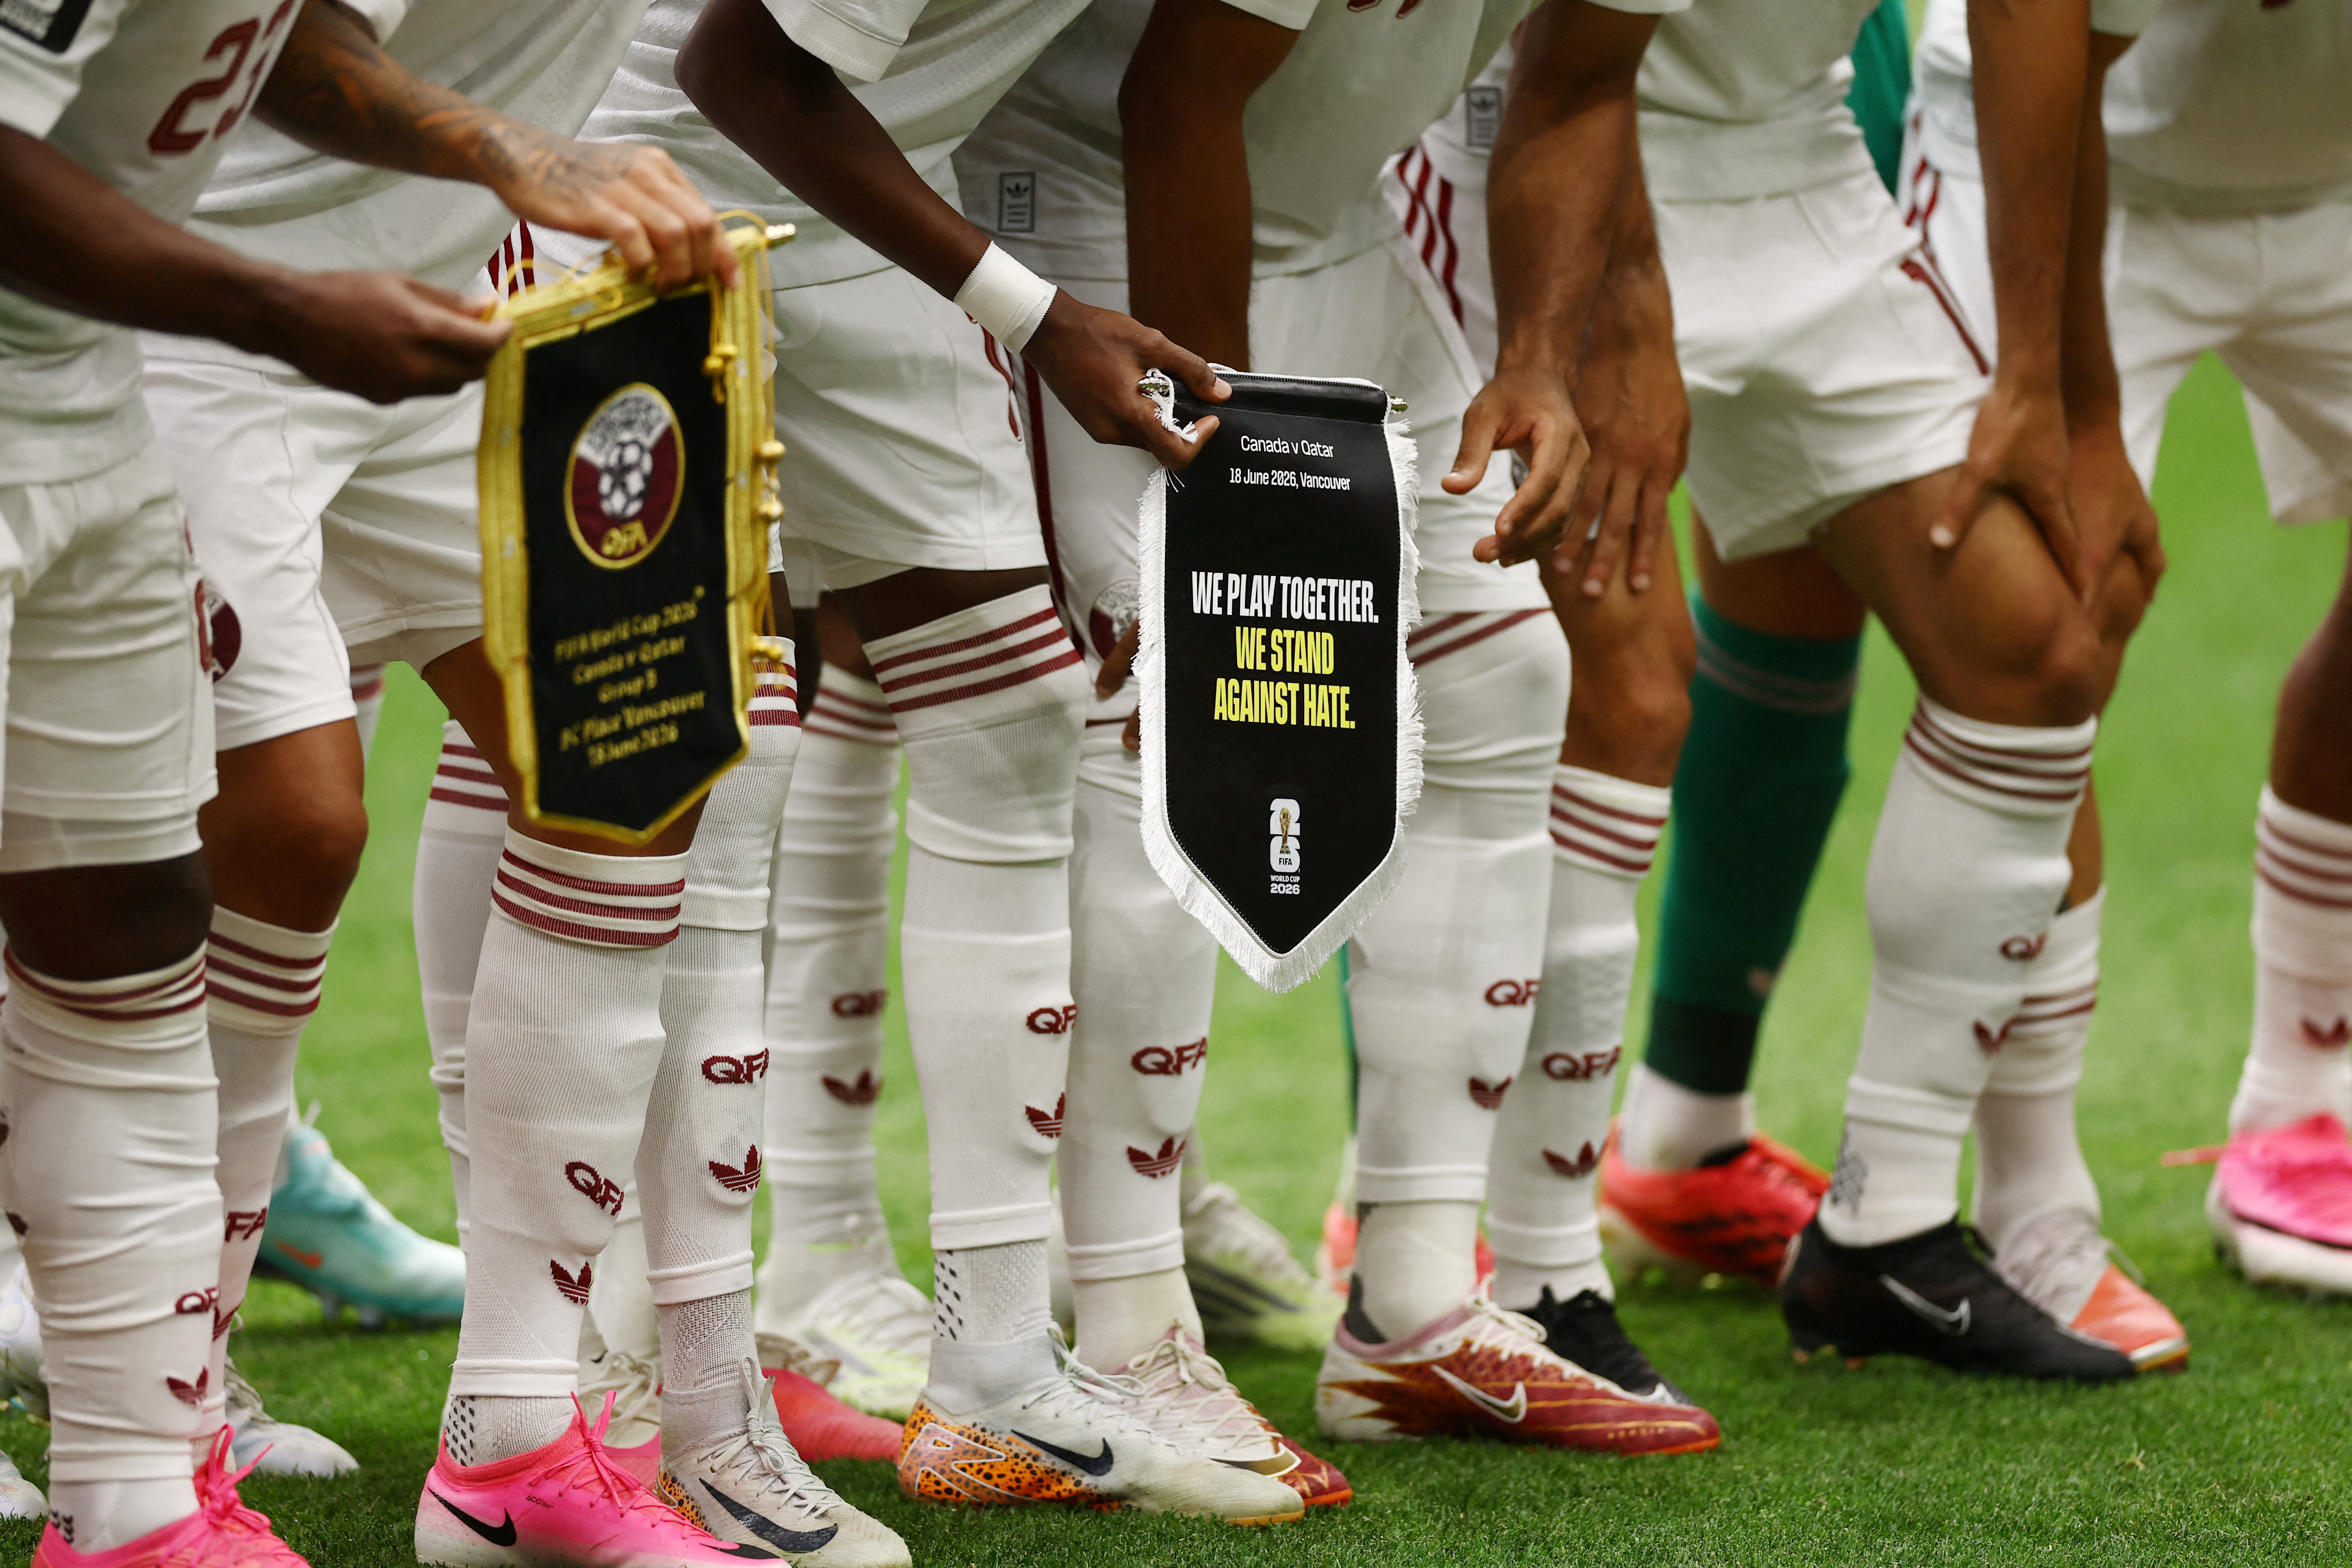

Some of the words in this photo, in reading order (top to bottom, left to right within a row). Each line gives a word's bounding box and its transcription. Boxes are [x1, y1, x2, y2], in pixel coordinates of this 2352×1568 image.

[1241, 435, 1290, 454] Canada
[1291, 442, 1298, 454] v
[1301, 440, 1334, 458] Qatar
[1229, 468, 1241, 483] 18
[1243, 468, 1269, 485] June
[1271, 470, 1299, 489] 2026,
[1299, 472, 1350, 491] Vancouver
[1192, 571, 1223, 615] WE
[1227, 573, 1276, 617] PLAY
[1279, 576, 1379, 623] TOGETHER.
[1236, 626, 1267, 670] WE
[1271, 628, 1334, 675] STAND
[1214, 678, 1299, 725] AGAINST
[1304, 683, 1356, 729] HATE.
[1279, 857, 1292, 866] FIFA
[1270, 883, 1300, 895] 2026
